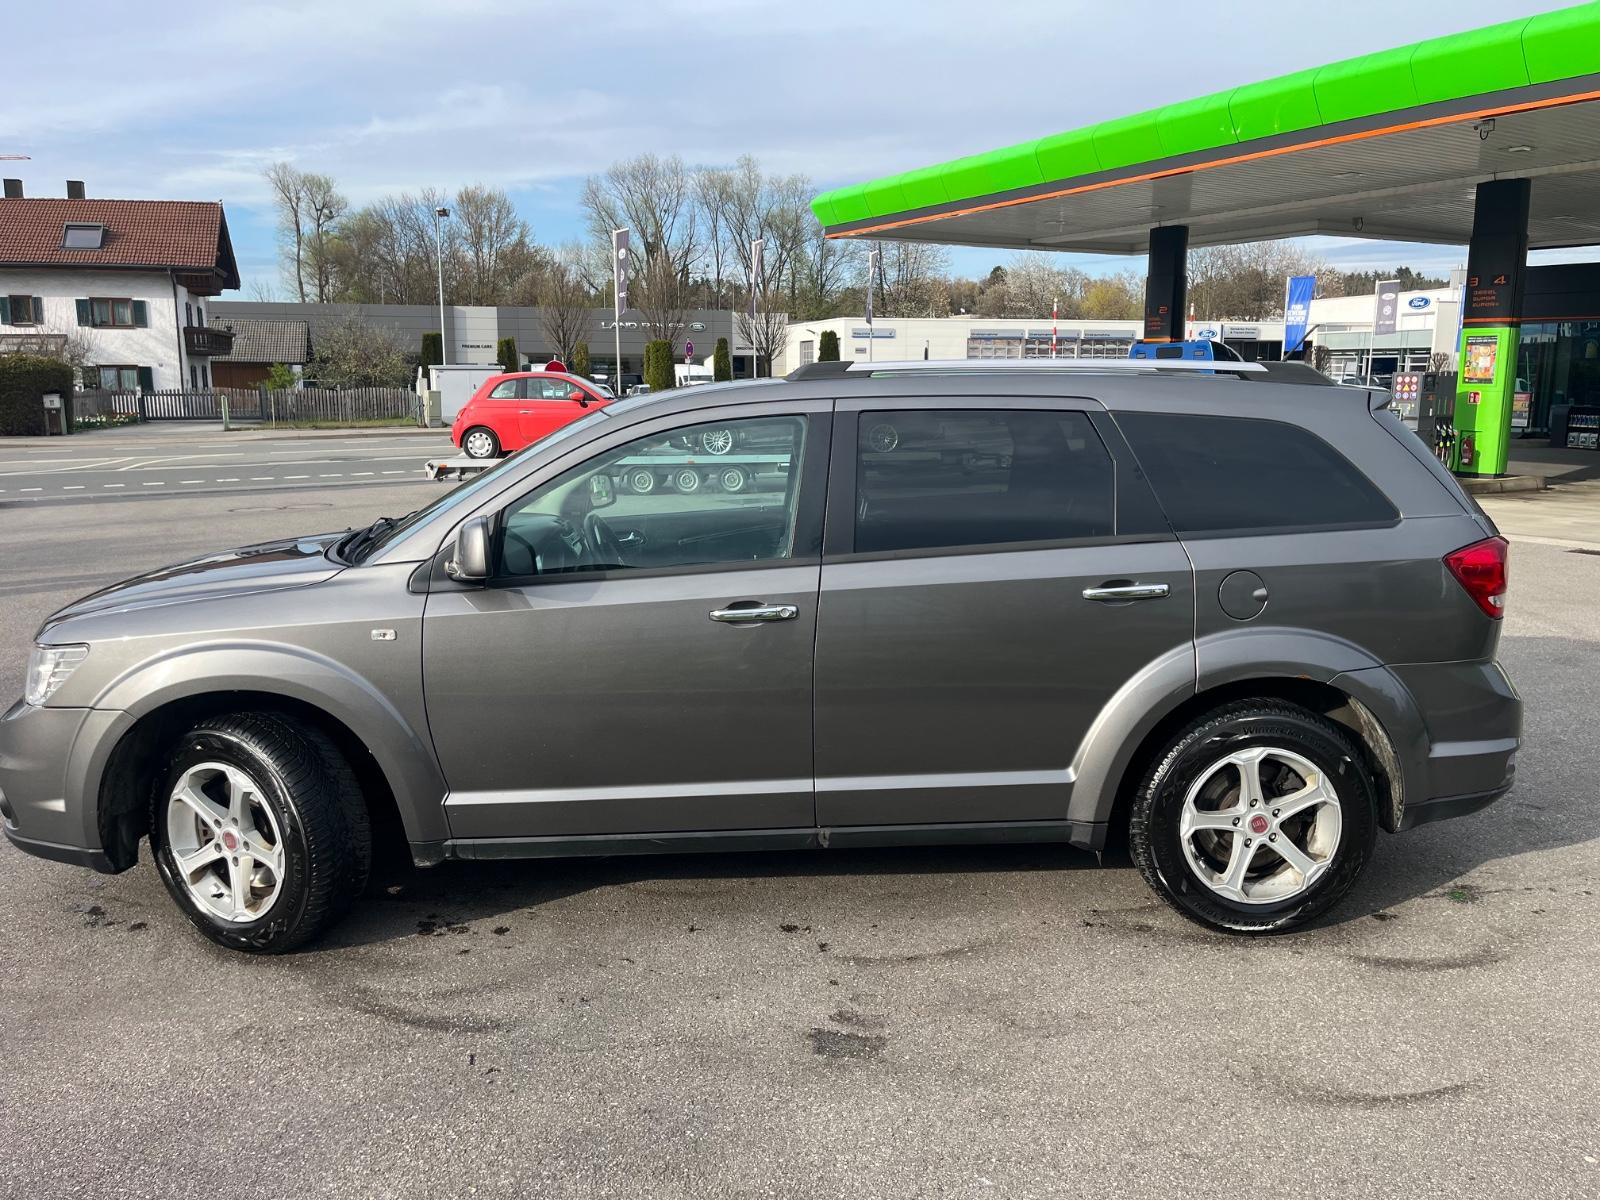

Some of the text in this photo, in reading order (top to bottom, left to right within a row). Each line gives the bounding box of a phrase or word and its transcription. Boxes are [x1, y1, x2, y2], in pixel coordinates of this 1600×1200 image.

[1470, 275, 1507, 287] 3 4
[1409, 297, 1430, 309] Ford
[1159, 306, 1168, 314] 2
[601, 321, 637, 329] LAND
